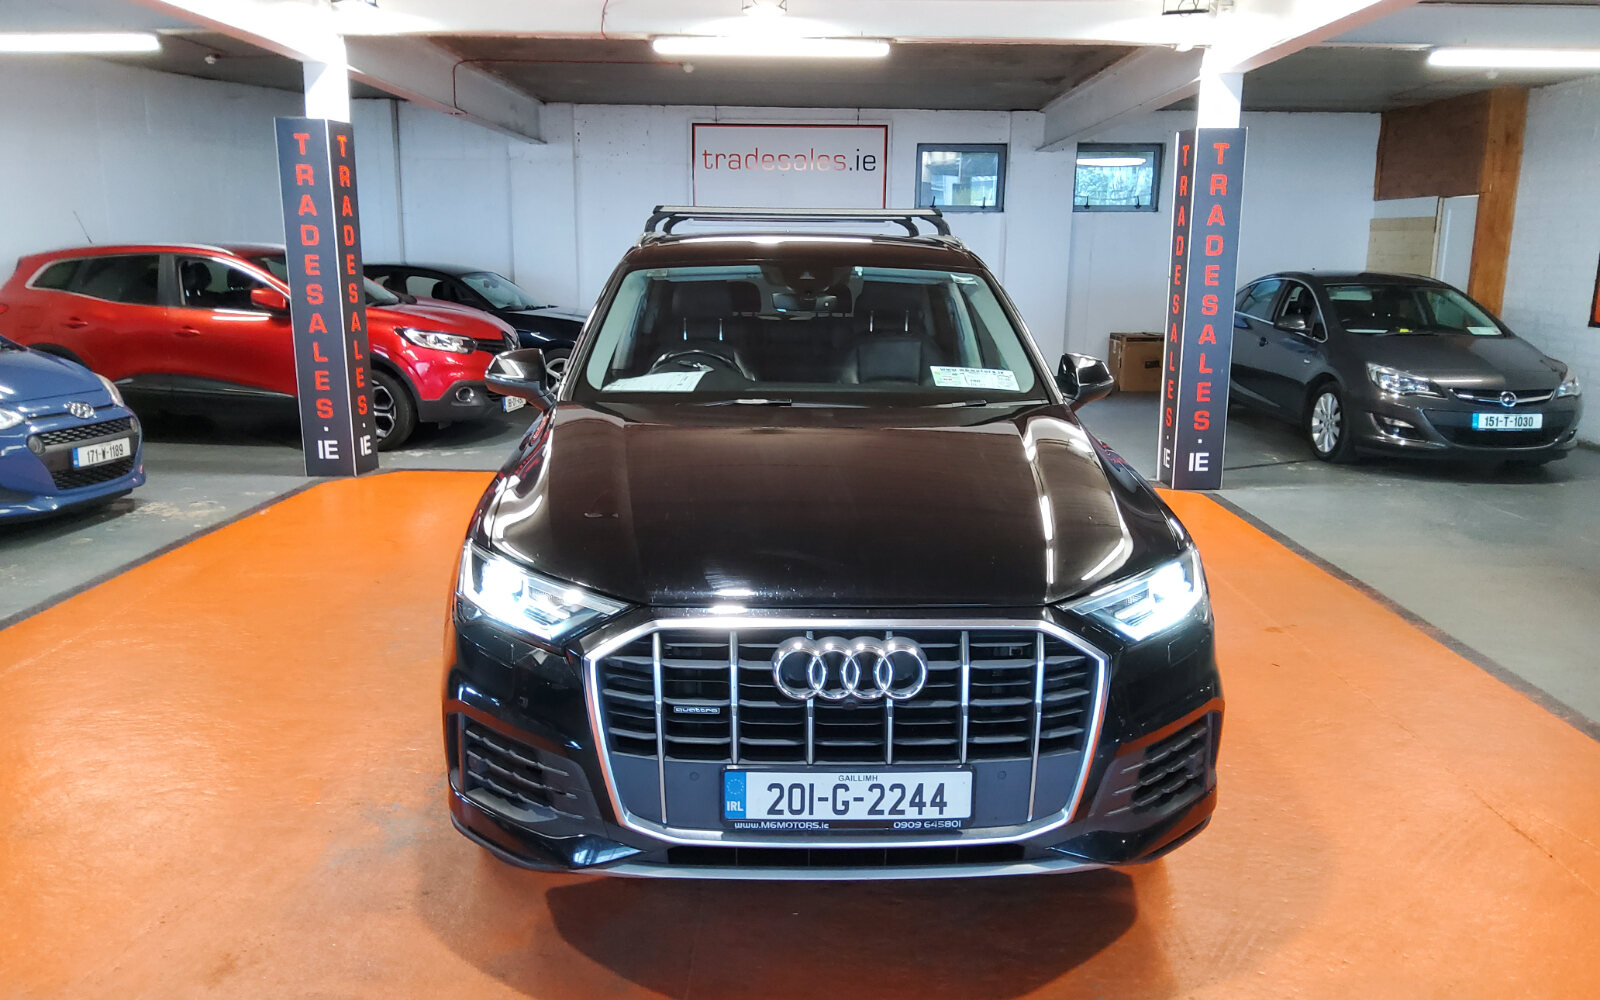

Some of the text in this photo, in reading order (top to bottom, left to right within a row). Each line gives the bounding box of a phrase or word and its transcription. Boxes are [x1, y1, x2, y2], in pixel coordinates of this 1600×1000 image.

[702, 147, 876, 171] tradesales.ie
[1485, 416, 1534, 427] 151-T-1030
[87, 443, 124, 464] 171-W-1189
[838, 774, 878, 782] GAILLIMH
[766, 782, 948, 816] 201-G-2244
[726, 801, 744, 812] IRL
[893, 820, 962, 829] 0909 645801
